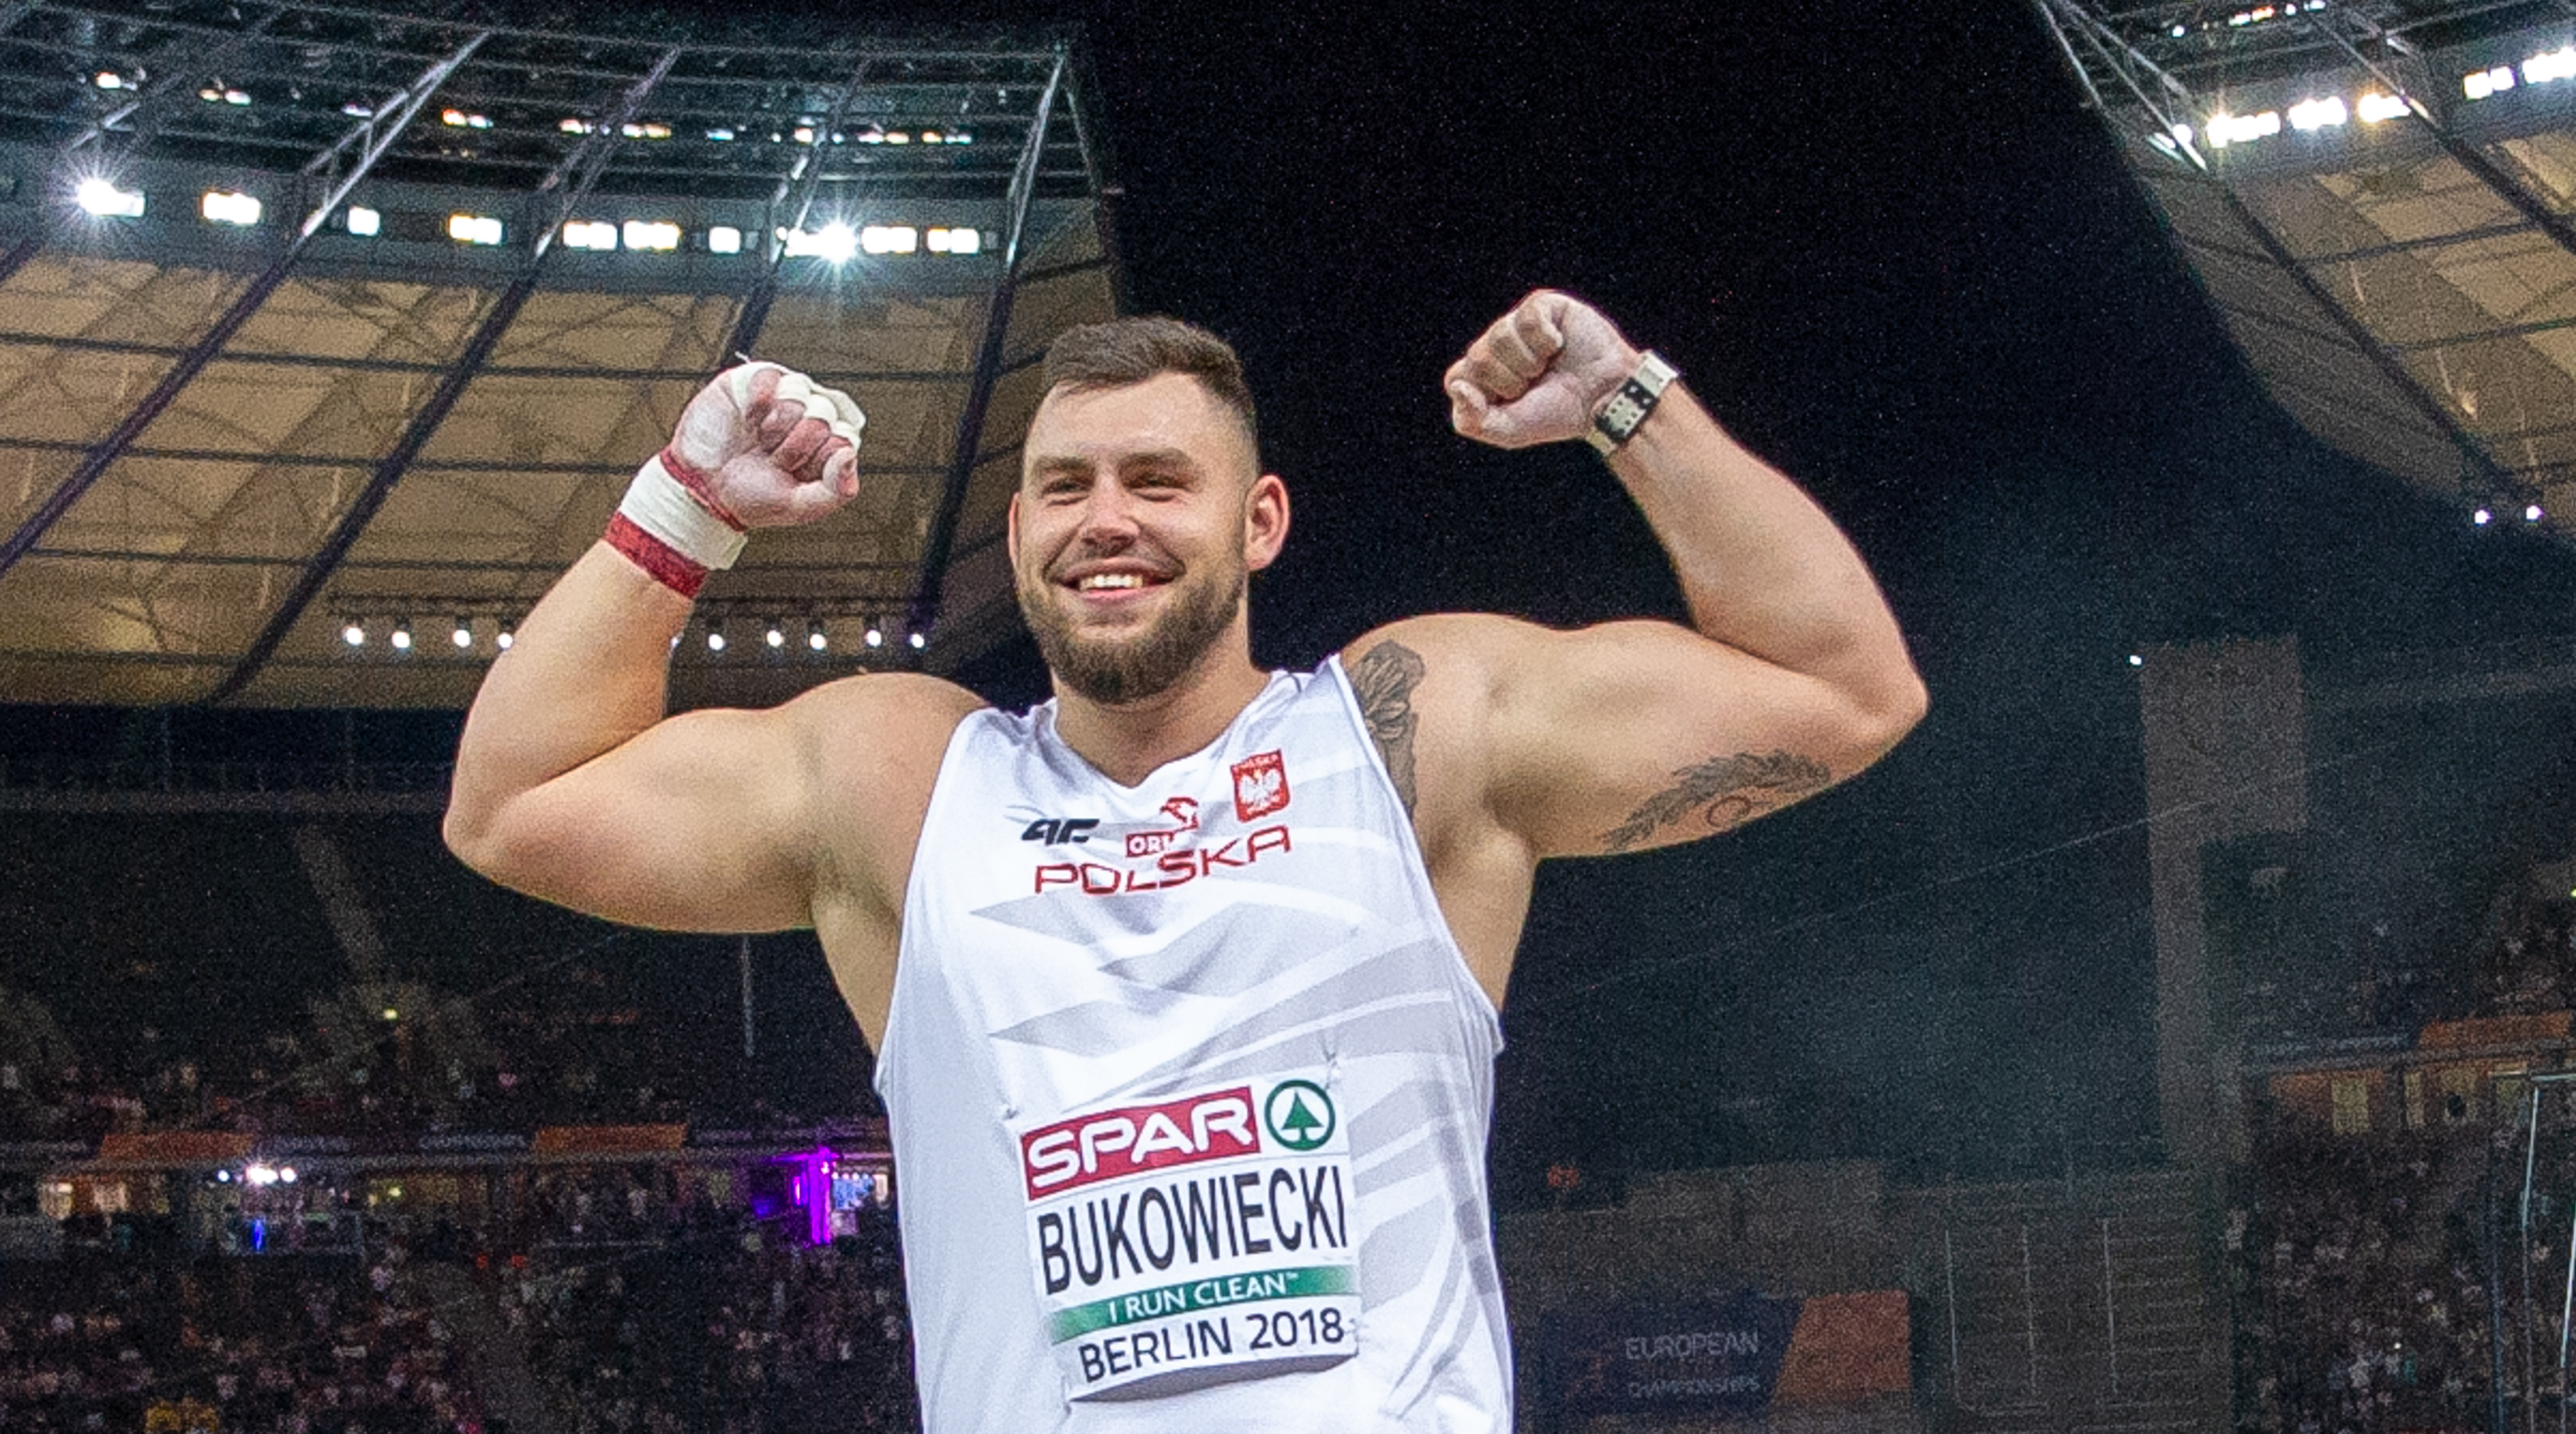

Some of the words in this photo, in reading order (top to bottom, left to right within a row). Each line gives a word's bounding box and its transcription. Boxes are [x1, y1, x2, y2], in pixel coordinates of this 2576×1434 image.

[1034, 826, 1291, 894] POLSKA
[1028, 1098, 1252, 1187] SPAR
[1038, 1166, 1347, 1295] BUKOWIECKI
[1108, 1303, 1117, 1323] I
[1126, 1287, 1187, 1319] RUN
[1078, 1316, 1233, 1384] BERLIN
[1246, 1307, 1345, 1350] 2018
[1625, 1331, 1758, 1360] EUROPEAN
[1627, 1375, 1760, 1398] CHAMPIONSHIPS
